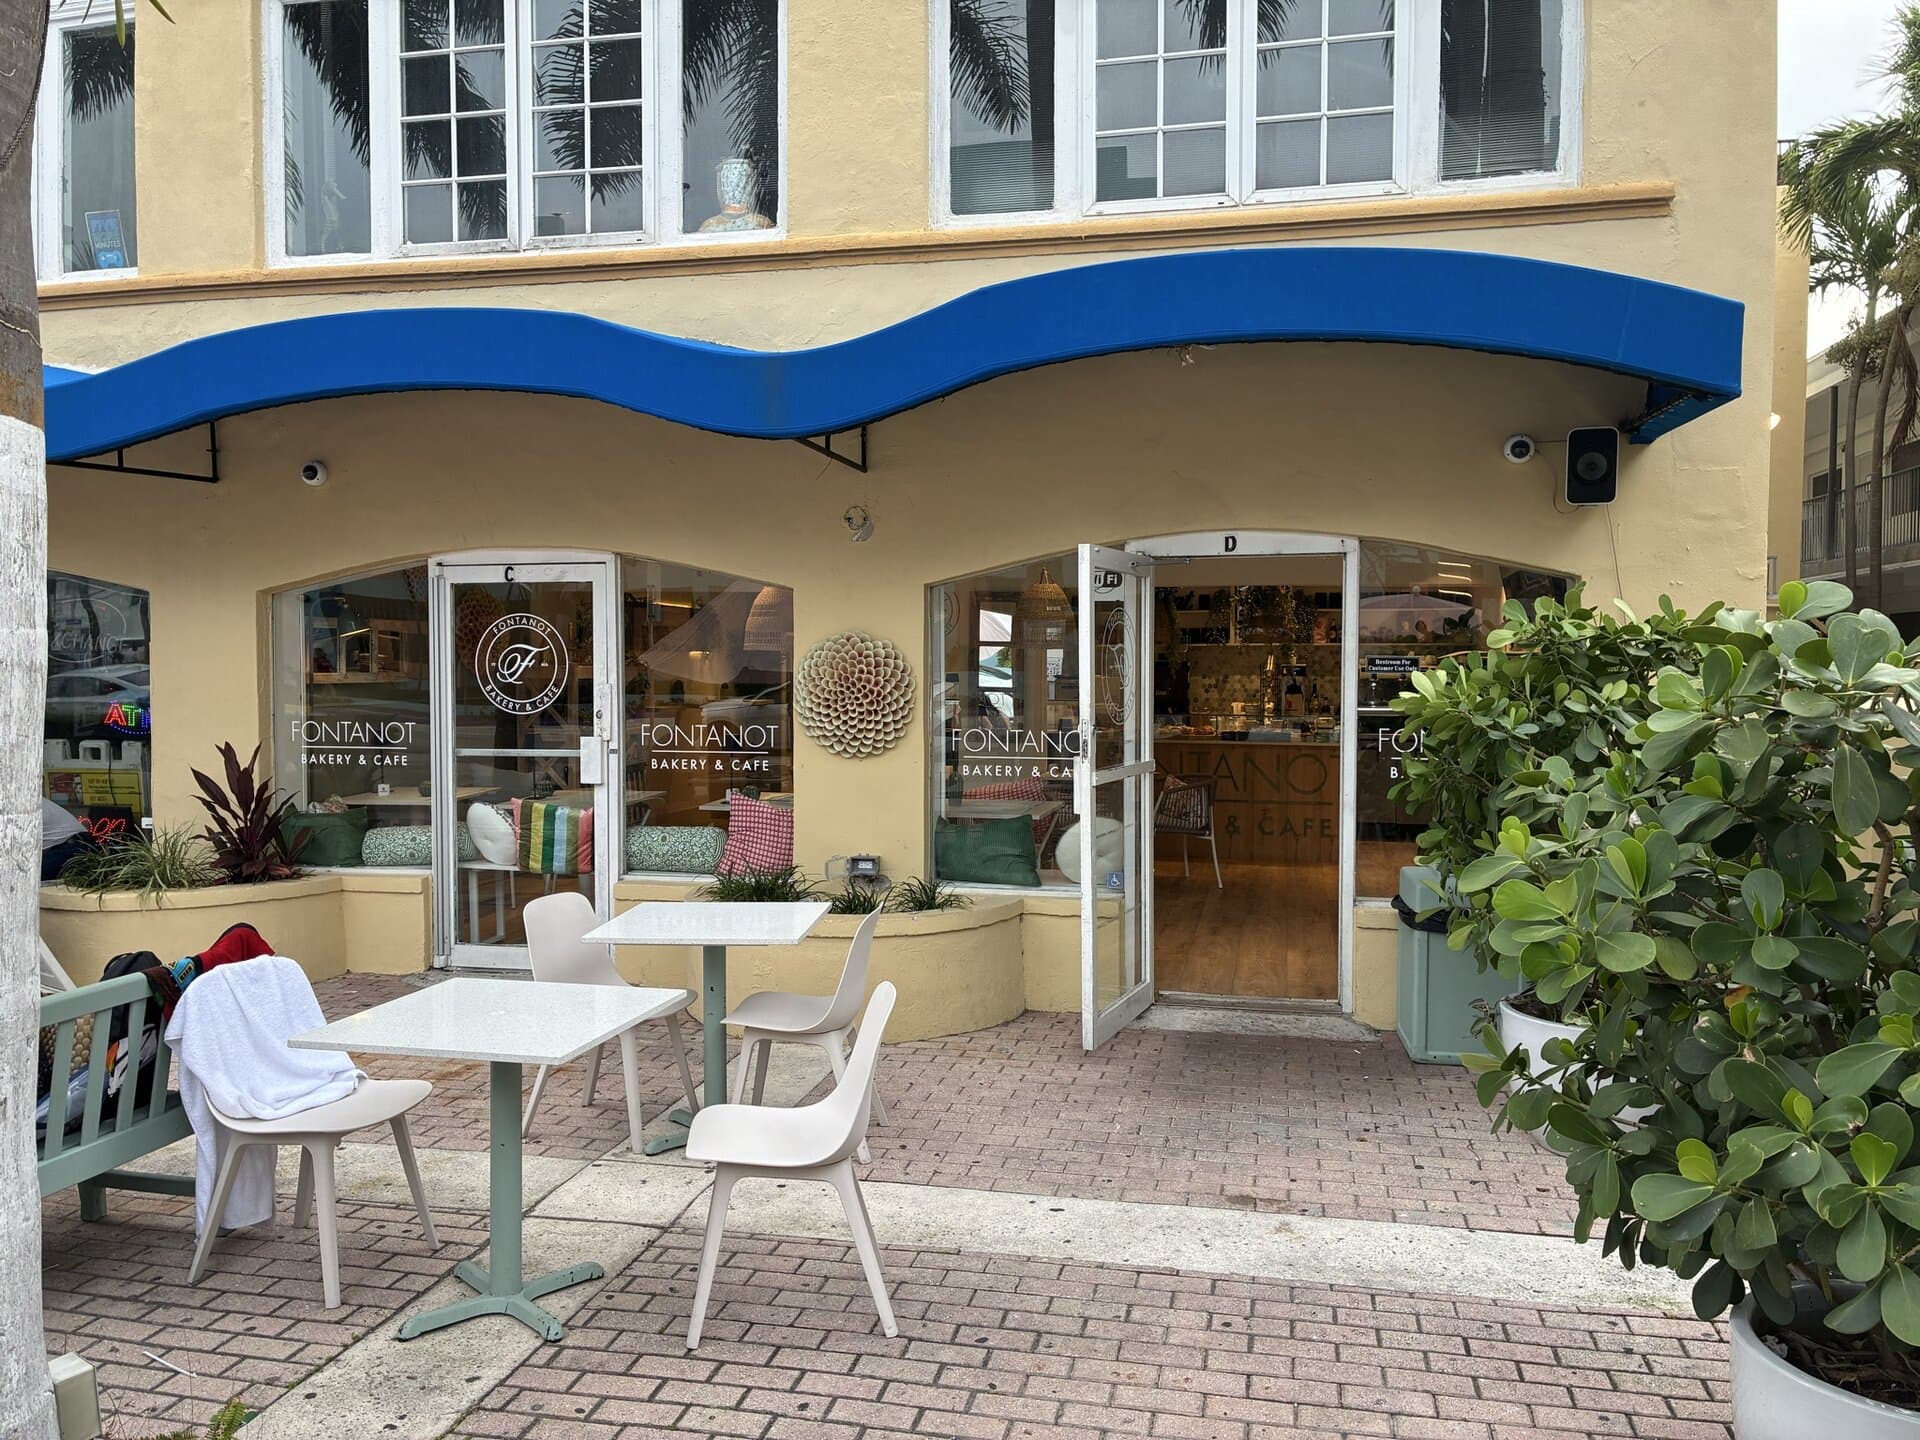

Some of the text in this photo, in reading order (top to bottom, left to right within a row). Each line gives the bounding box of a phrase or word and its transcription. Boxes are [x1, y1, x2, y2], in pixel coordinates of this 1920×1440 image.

[1225, 535, 1237, 552] D
[505, 566, 514, 582] C
[493, 616, 551, 635] FONTANOT
[485, 684, 559, 711] BAKERY & CAFE
[291, 720, 417, 744] FONTANOT
[641, 723, 779, 748] FONTANOT
[952, 728, 1081, 754] FONTANO
[301, 753, 408, 766] BAKERY & CAFE
[651, 758, 769, 771] BAKERY & CAFE
[962, 764, 1072, 778] BAKERY & CA
[1259, 815, 1332, 838] CAFE
